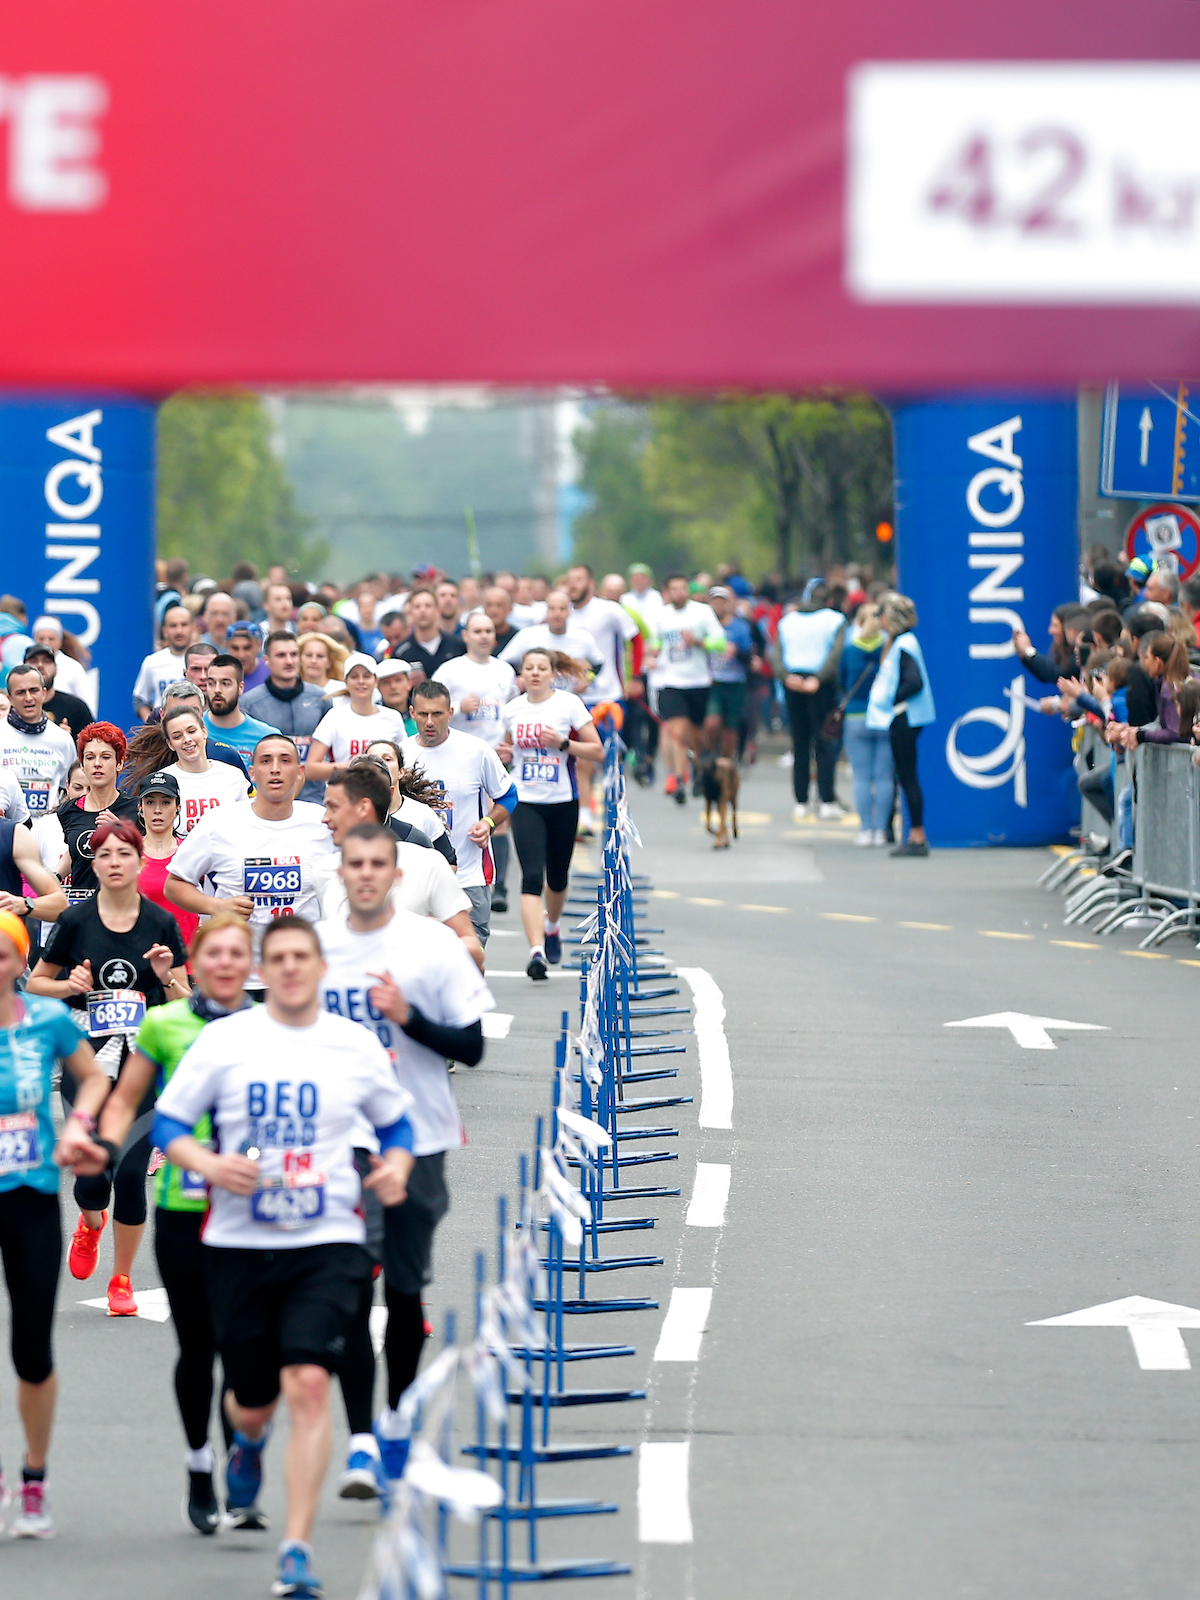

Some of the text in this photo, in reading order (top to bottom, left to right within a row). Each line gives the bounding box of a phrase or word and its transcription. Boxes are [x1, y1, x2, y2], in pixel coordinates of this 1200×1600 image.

[918, 120, 1092, 242] 42
[44, 408, 103, 649] UNIQA
[966, 414, 1026, 660] UNIQA
[2, 757, 57, 767] BELhospice
[22, 766, 39, 775] TIM
[524, 764, 557, 781] 3149
[246, 870, 300, 891] 7968
[95, 1003, 139, 1025] 6857
[247, 1081, 319, 1118] BEO
